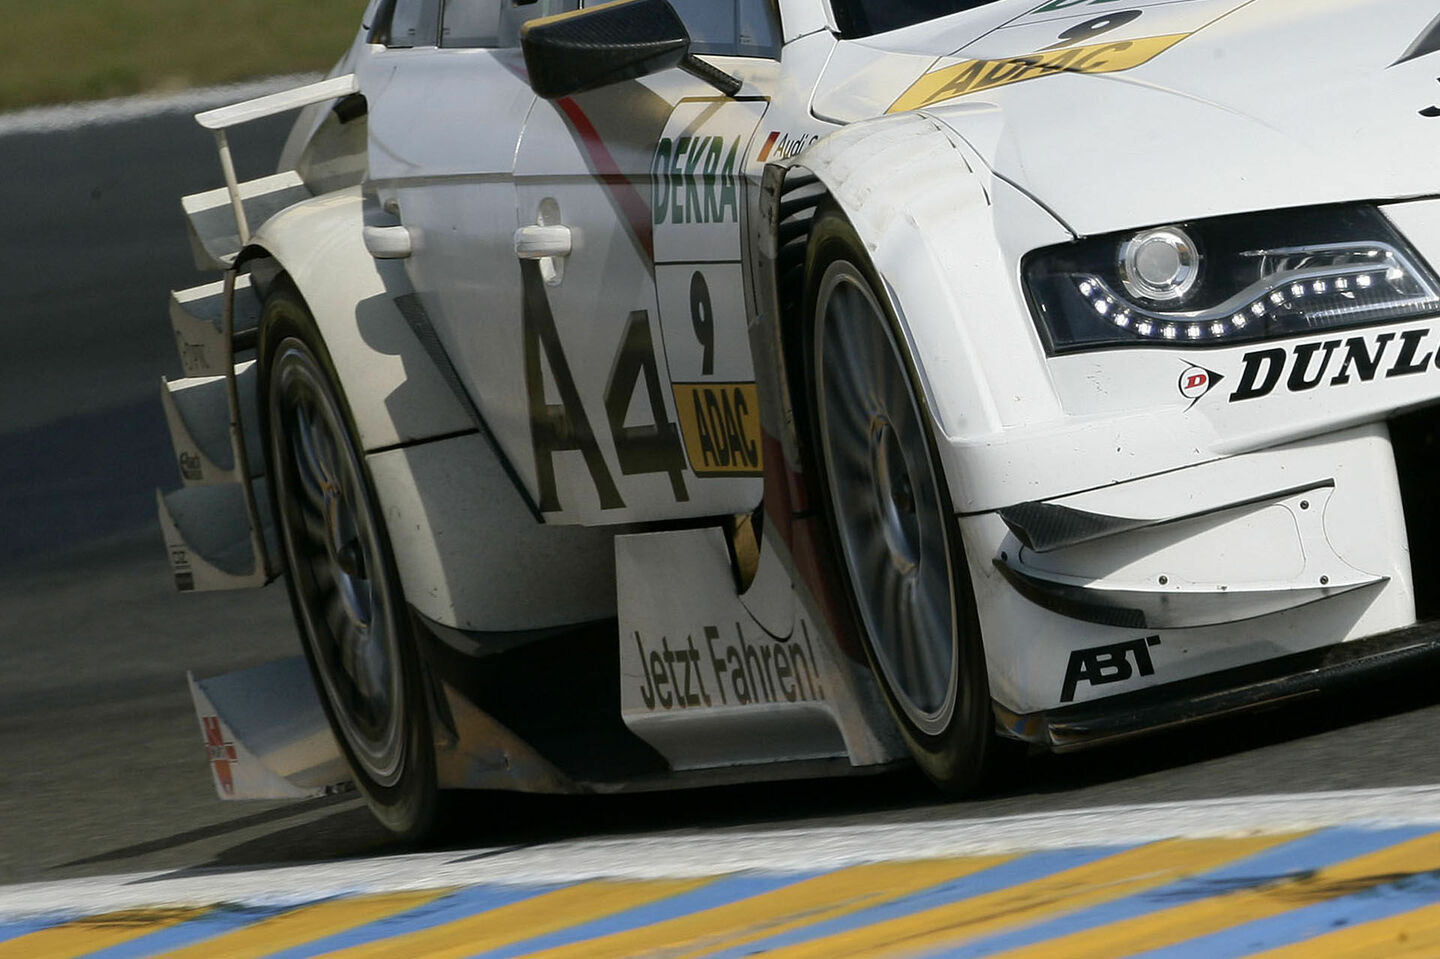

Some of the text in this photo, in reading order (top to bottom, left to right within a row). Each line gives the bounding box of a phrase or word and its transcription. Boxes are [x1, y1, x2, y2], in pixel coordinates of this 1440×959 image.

[922, 41, 1134, 104] ADAC
[654, 133, 742, 225] DEKRA
[773, 132, 808, 159] Audi
[690, 270, 714, 376] 9
[521, 258, 690, 513] A4
[692, 386, 759, 468] ADAC
[640, 618, 825, 710] Jetzt Fahren!
[1060, 634, 1161, 702] ABT
